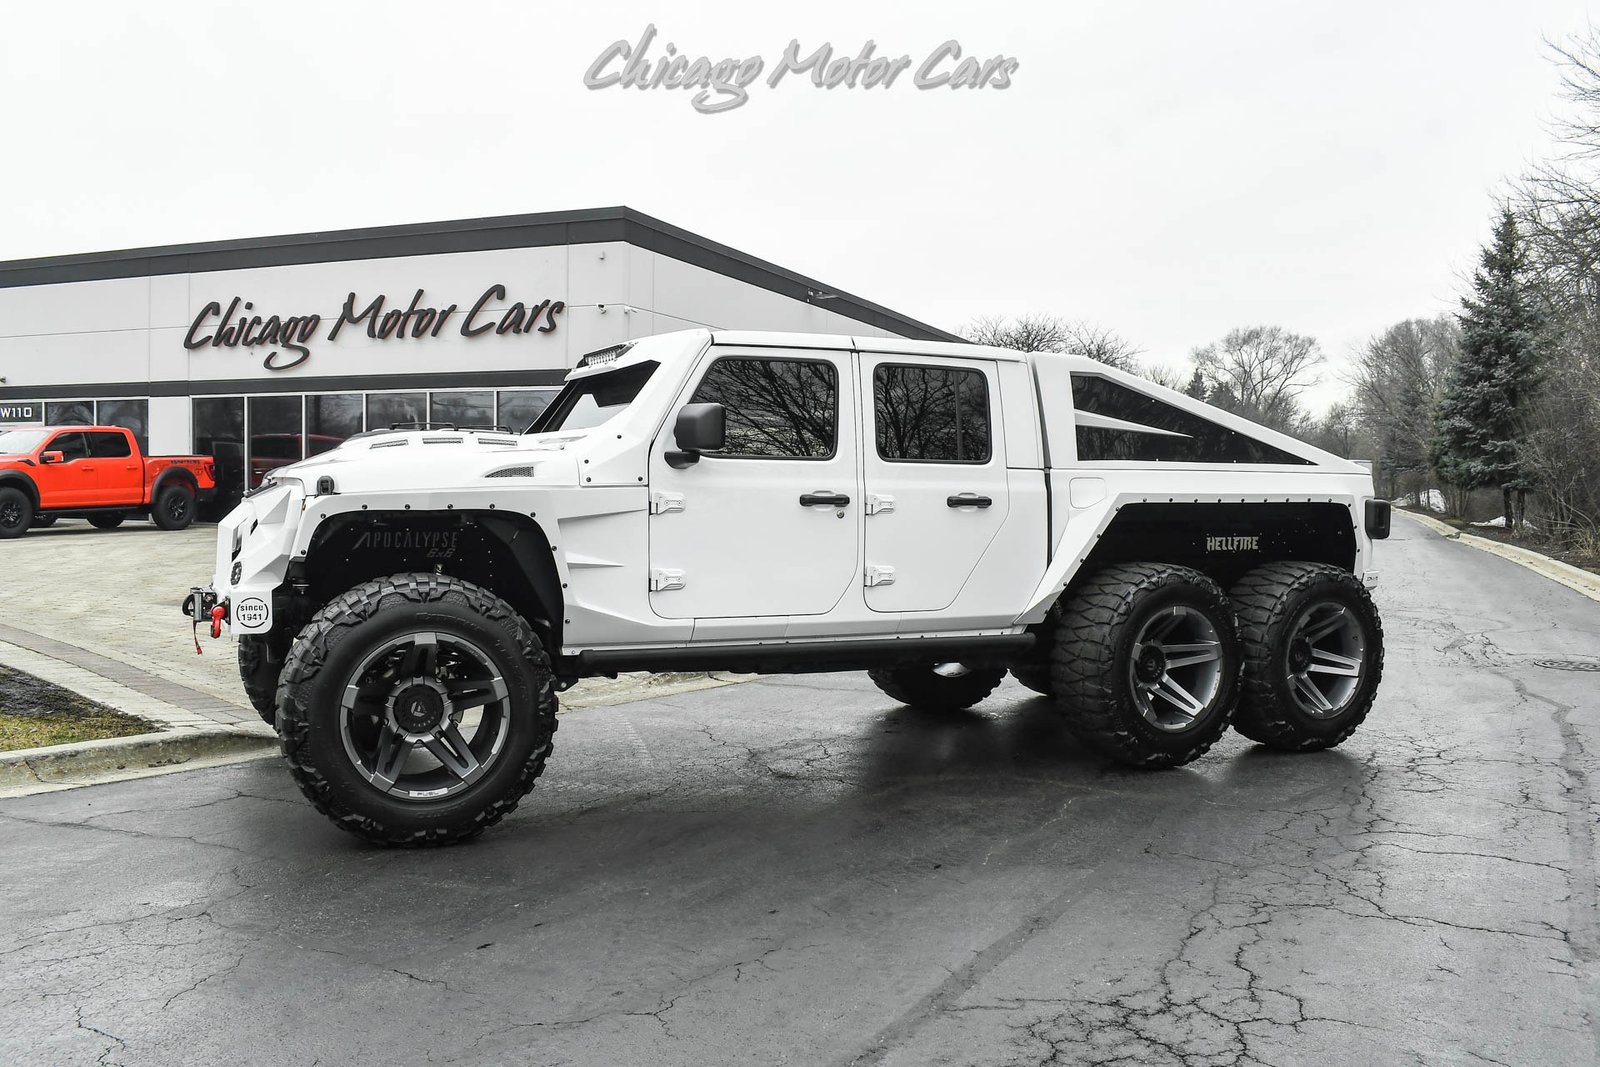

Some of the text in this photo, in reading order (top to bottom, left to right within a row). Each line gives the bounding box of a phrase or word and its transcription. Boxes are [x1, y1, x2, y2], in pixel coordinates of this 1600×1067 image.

[184, 283, 565, 371] Chicago Motor Cars
[352, 531, 459, 551] APOCALYPSE
[1206, 536, 1259, 552] HELLFIRE
[240, 604, 264, 612] since
[241, 613, 263, 621] 1941
